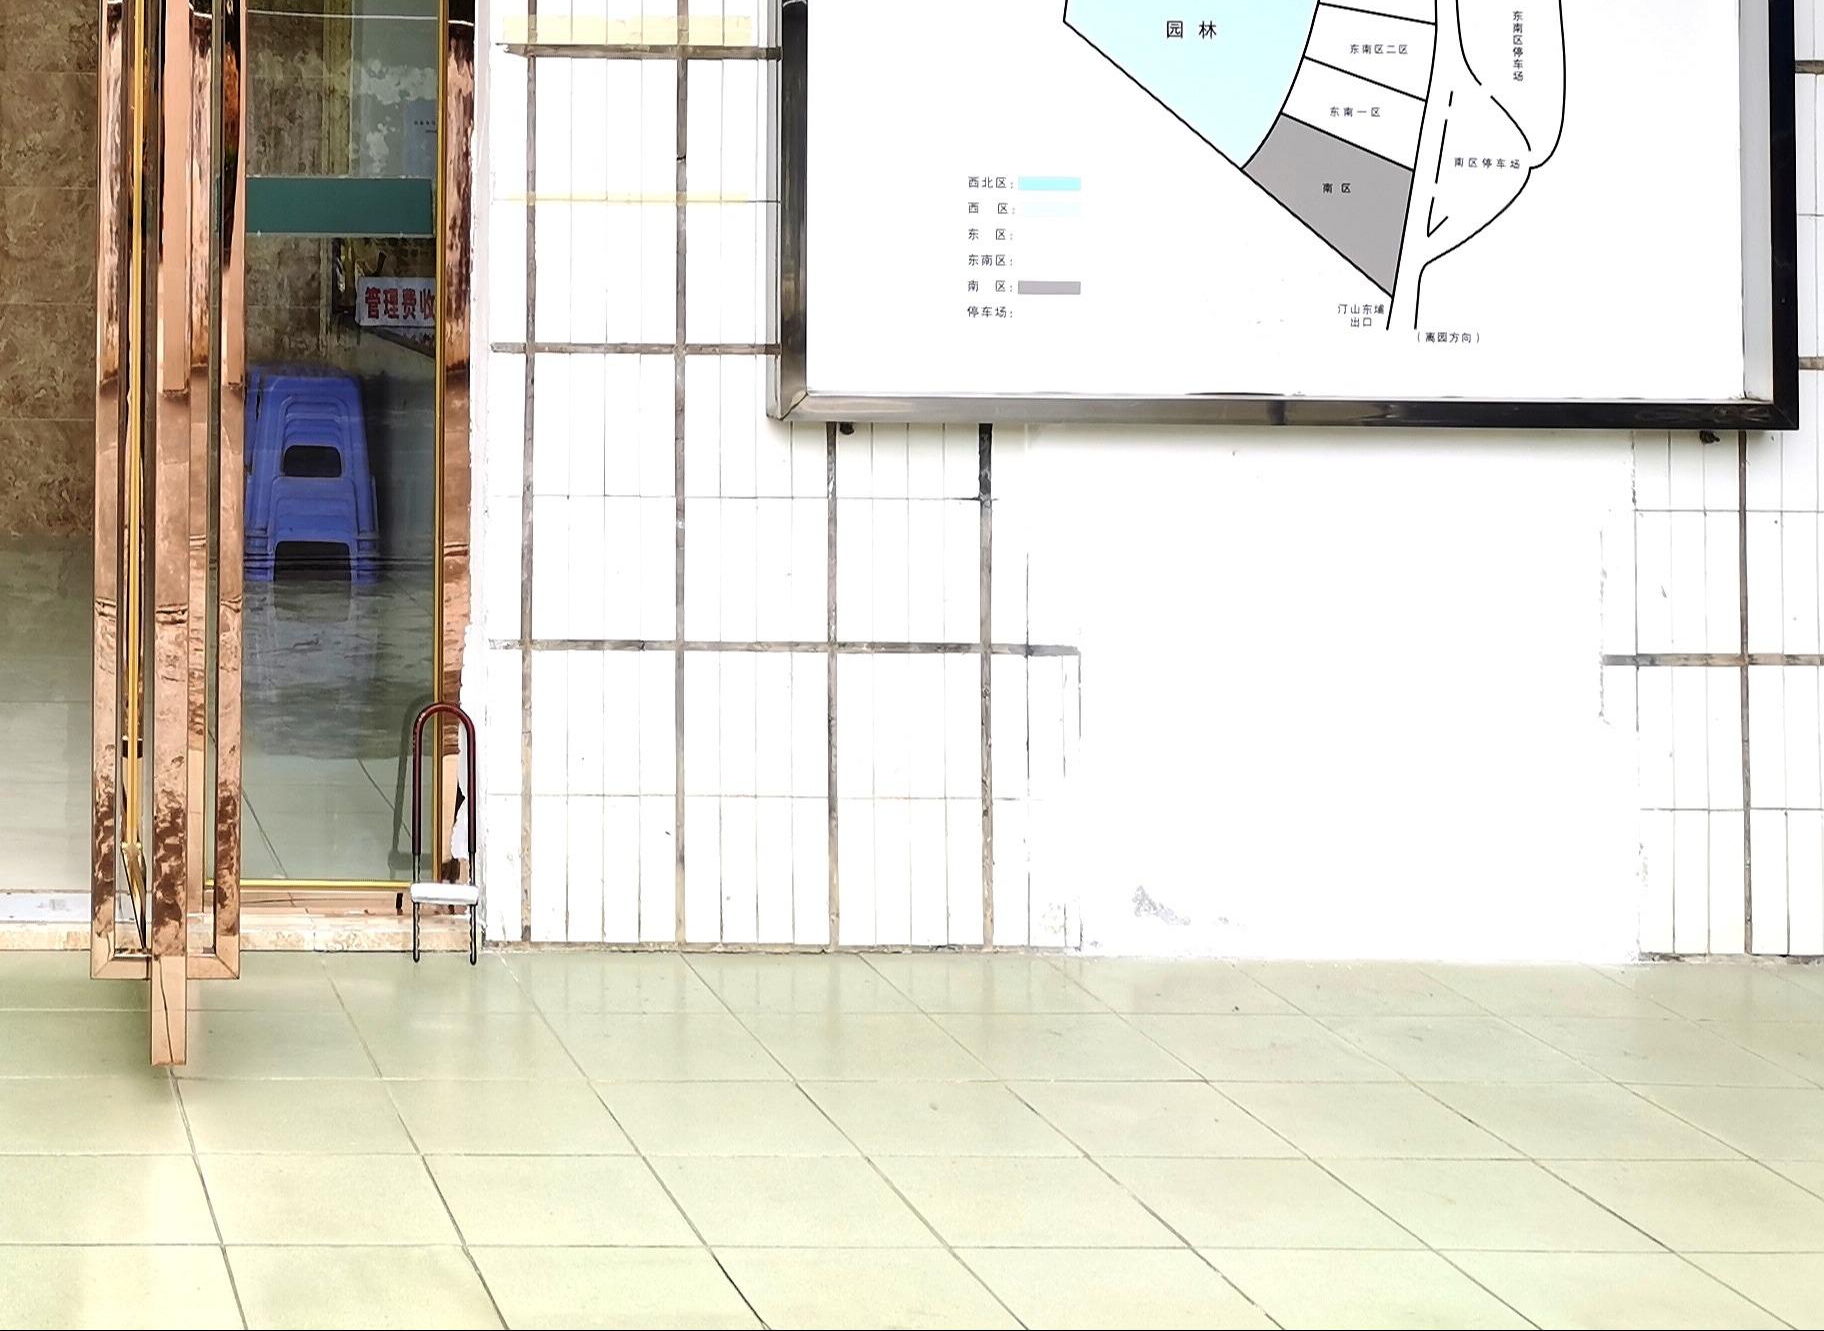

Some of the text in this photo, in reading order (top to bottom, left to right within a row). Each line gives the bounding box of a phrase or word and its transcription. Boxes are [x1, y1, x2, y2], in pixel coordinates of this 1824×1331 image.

[1164, 19, 1219, 41] 园林
[1350, 44, 1408, 54] 东南区二区
[1512, 11, 1523, 81] 东南区停车场
[1330, 107, 1380, 117] 东南一区
[1454, 158, 1520, 168] 南区停车场
[968, 176, 1014, 189] 西北区:
[1322, 183, 1351, 194] 南区
[968, 254, 1013, 266] 东南区:
[967, 306, 1013, 318] 停车场:
[1350, 318, 1372, 327] 出口
